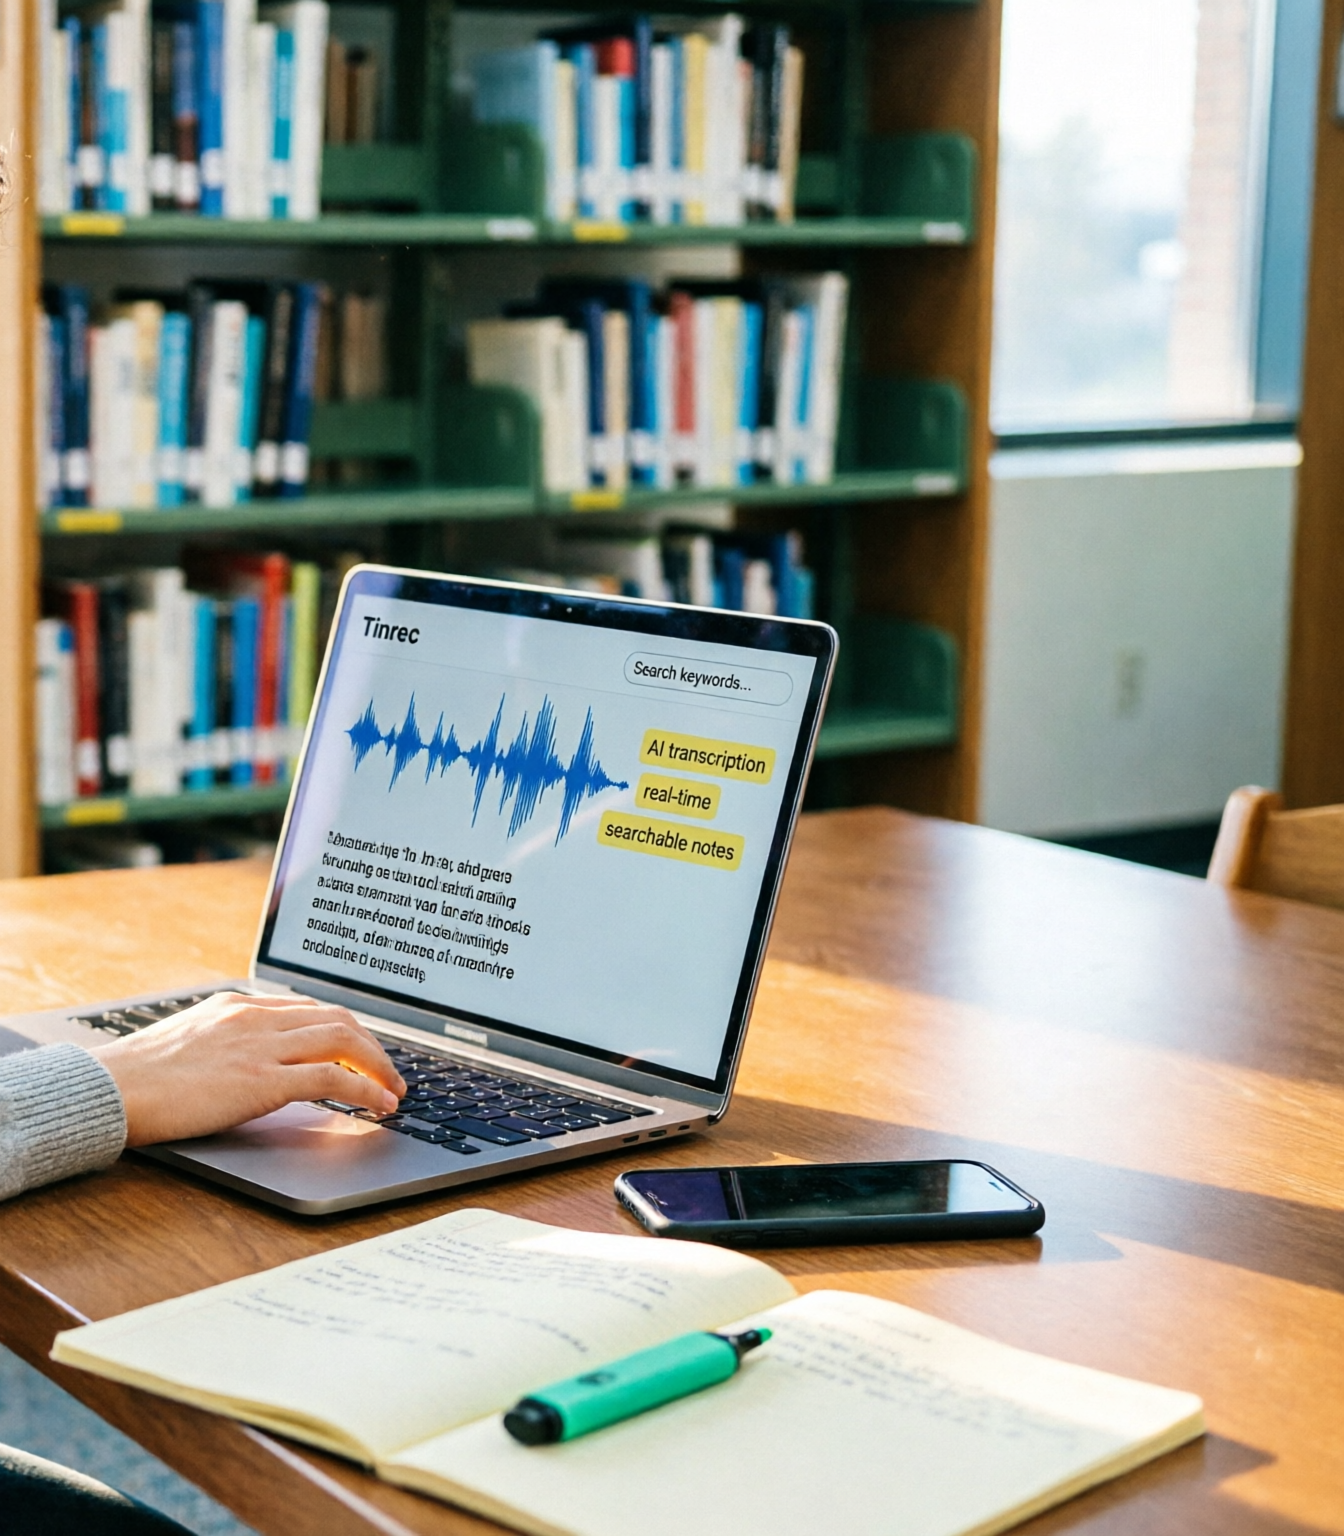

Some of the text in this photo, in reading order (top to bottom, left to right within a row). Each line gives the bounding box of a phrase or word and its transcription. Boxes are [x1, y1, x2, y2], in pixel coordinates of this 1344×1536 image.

[364, 616, 420, 644] Tinrec
[633, 661, 752, 691] Search keywords...
[647, 739, 766, 774] AI transcription
[643, 786, 711, 810] real-time
[605, 823, 735, 860] searchable notes
